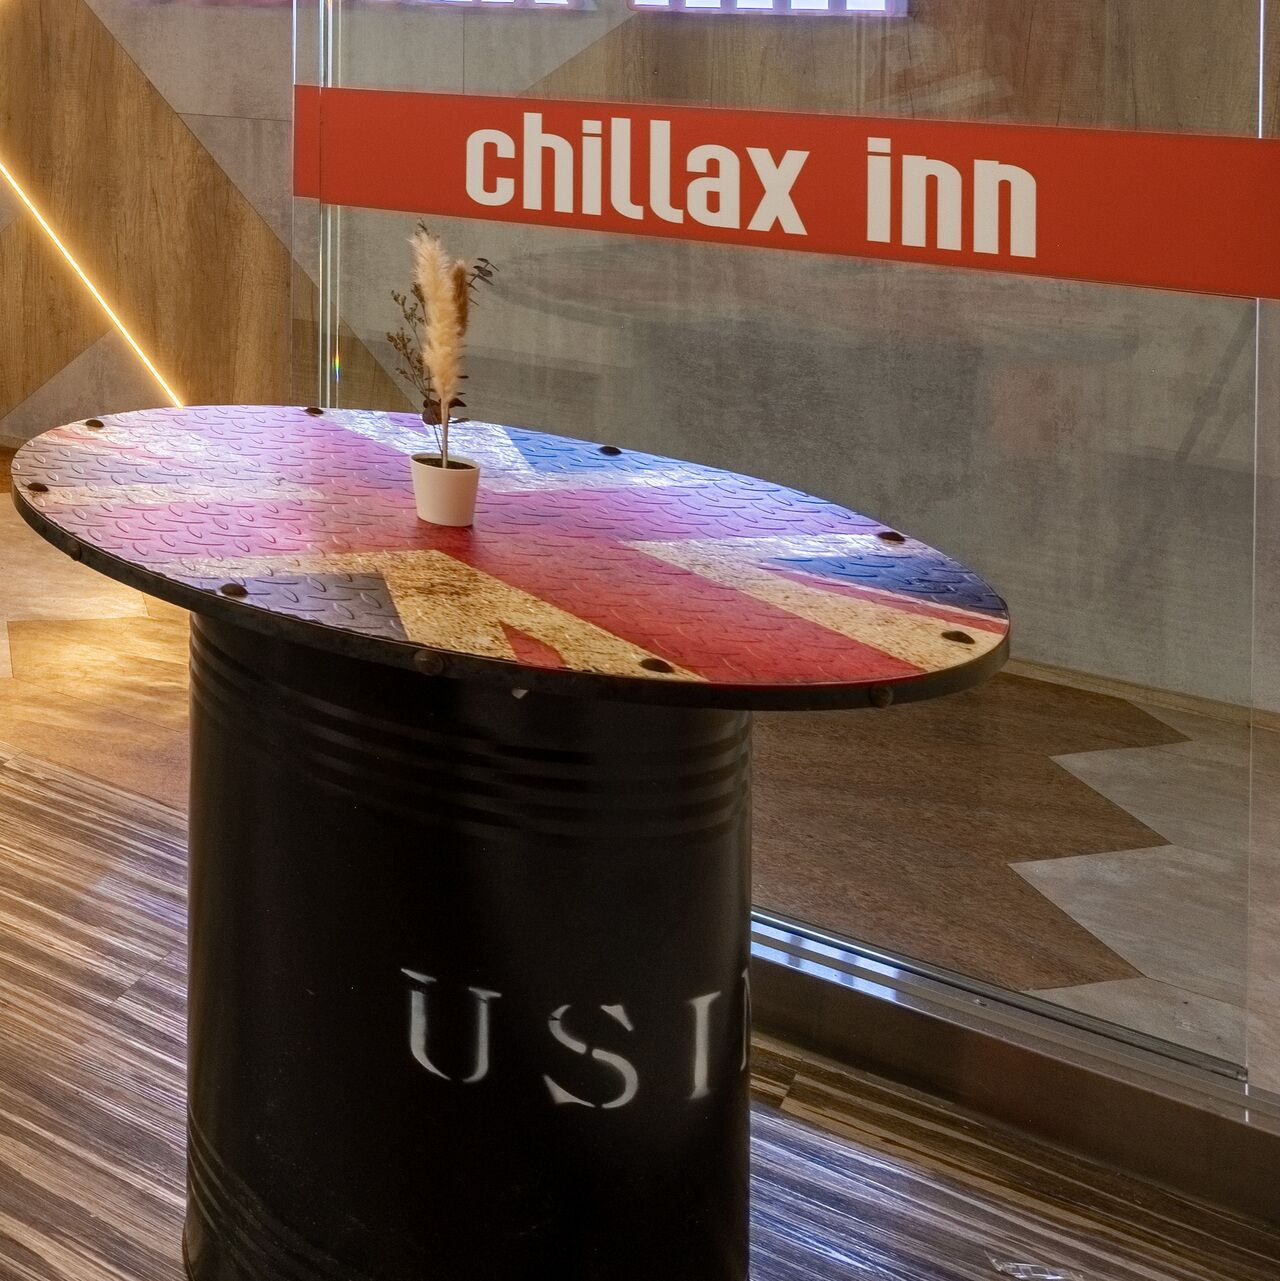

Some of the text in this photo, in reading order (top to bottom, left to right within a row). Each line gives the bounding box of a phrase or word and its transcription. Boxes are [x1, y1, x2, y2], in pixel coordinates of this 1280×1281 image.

[465, 112, 1037, 259] chillax inn
[400, 968, 751, 1109] USI
